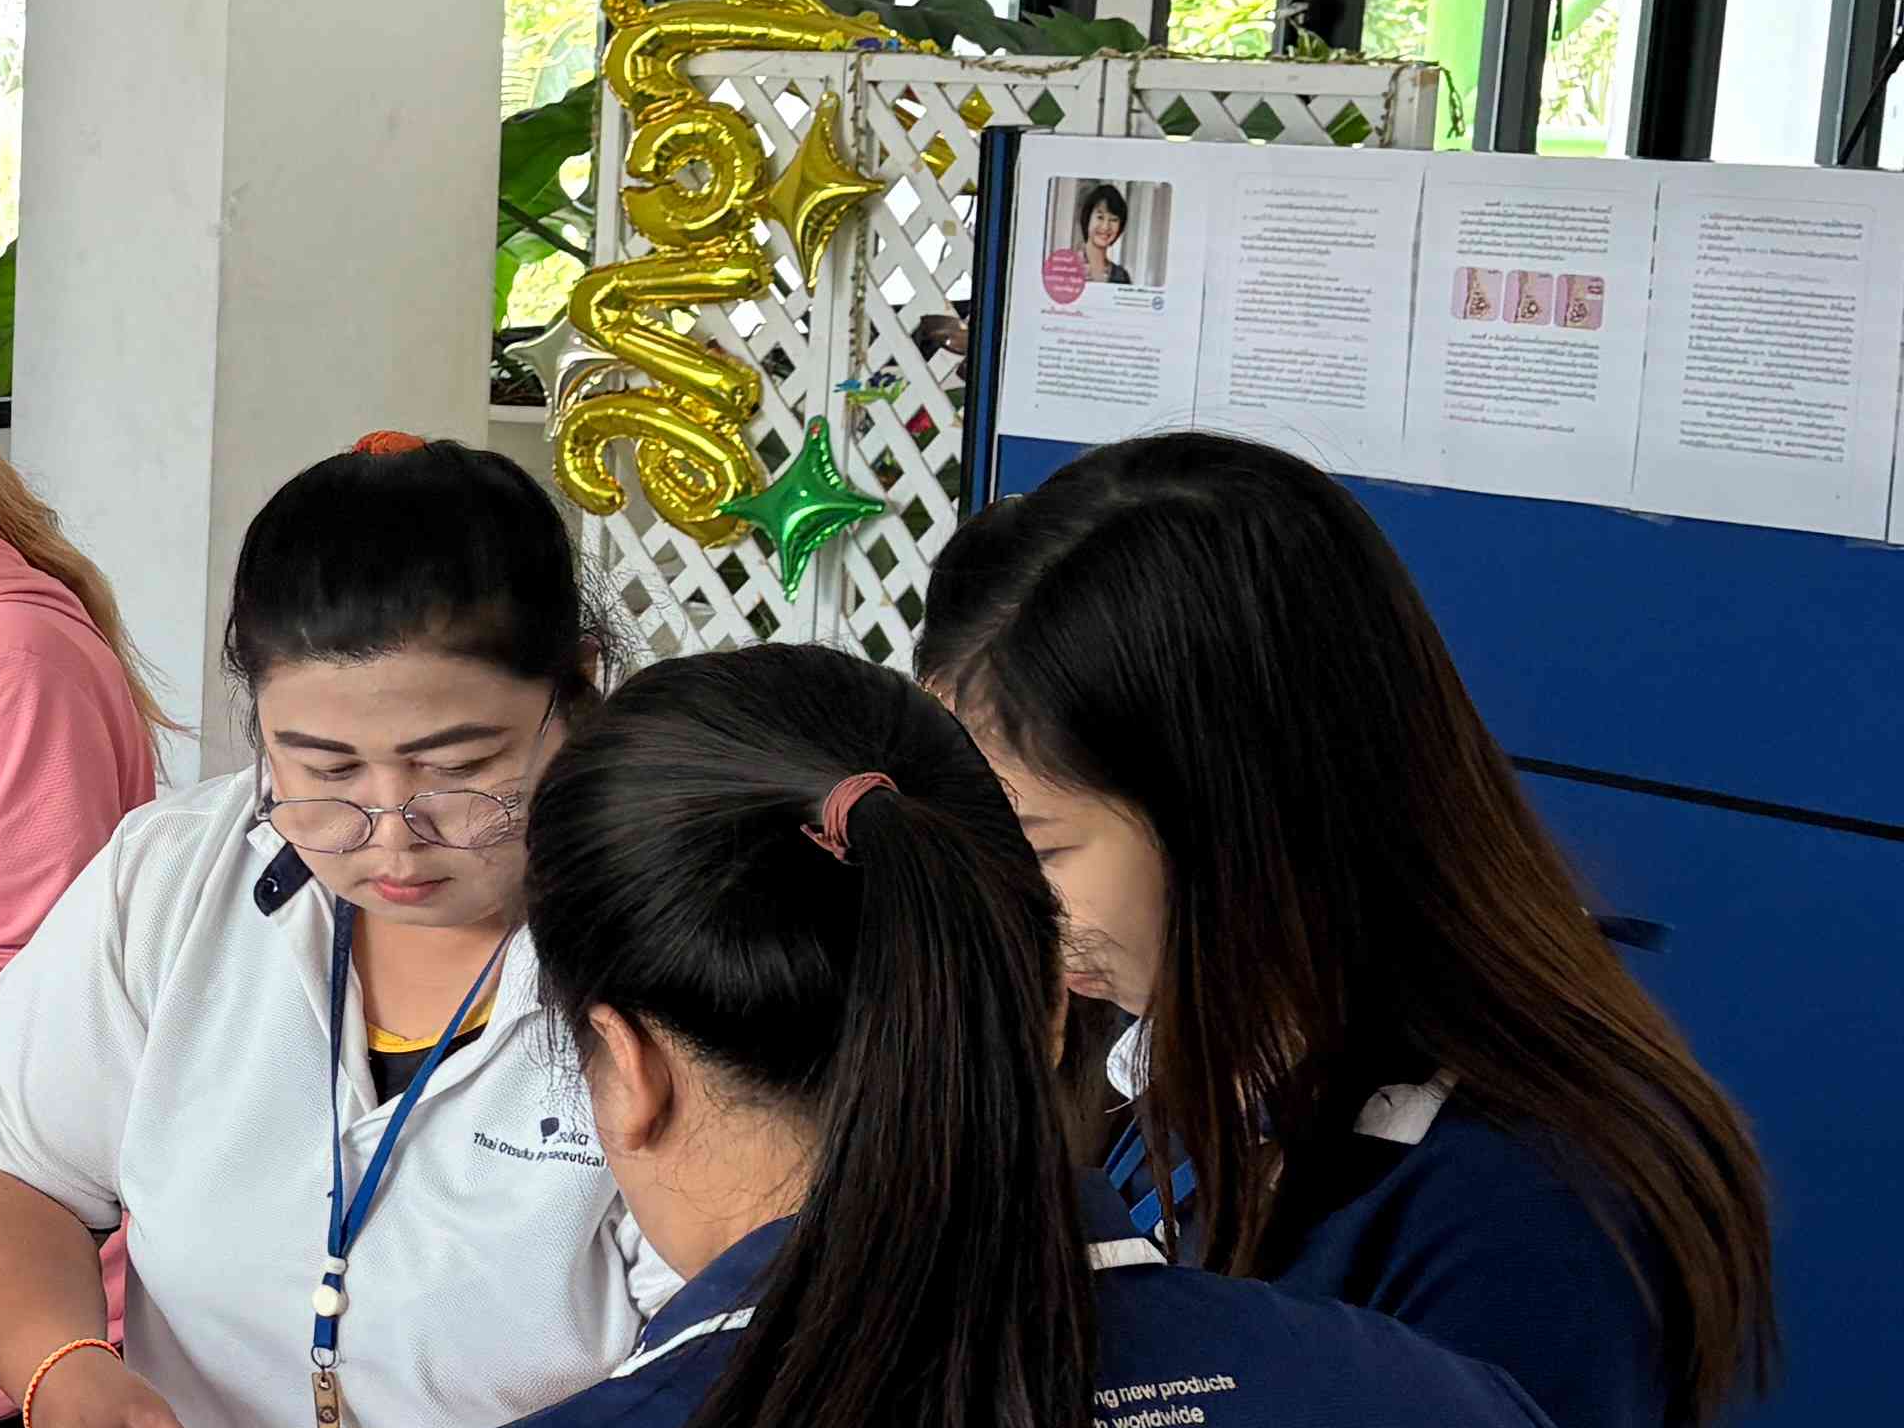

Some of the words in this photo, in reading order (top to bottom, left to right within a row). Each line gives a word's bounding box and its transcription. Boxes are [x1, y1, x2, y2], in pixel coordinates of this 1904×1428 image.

[473, 1132, 498, 1150] Thai
[1119, 1383, 1157, 1403] new
[1158, 1374, 1236, 1401] products
